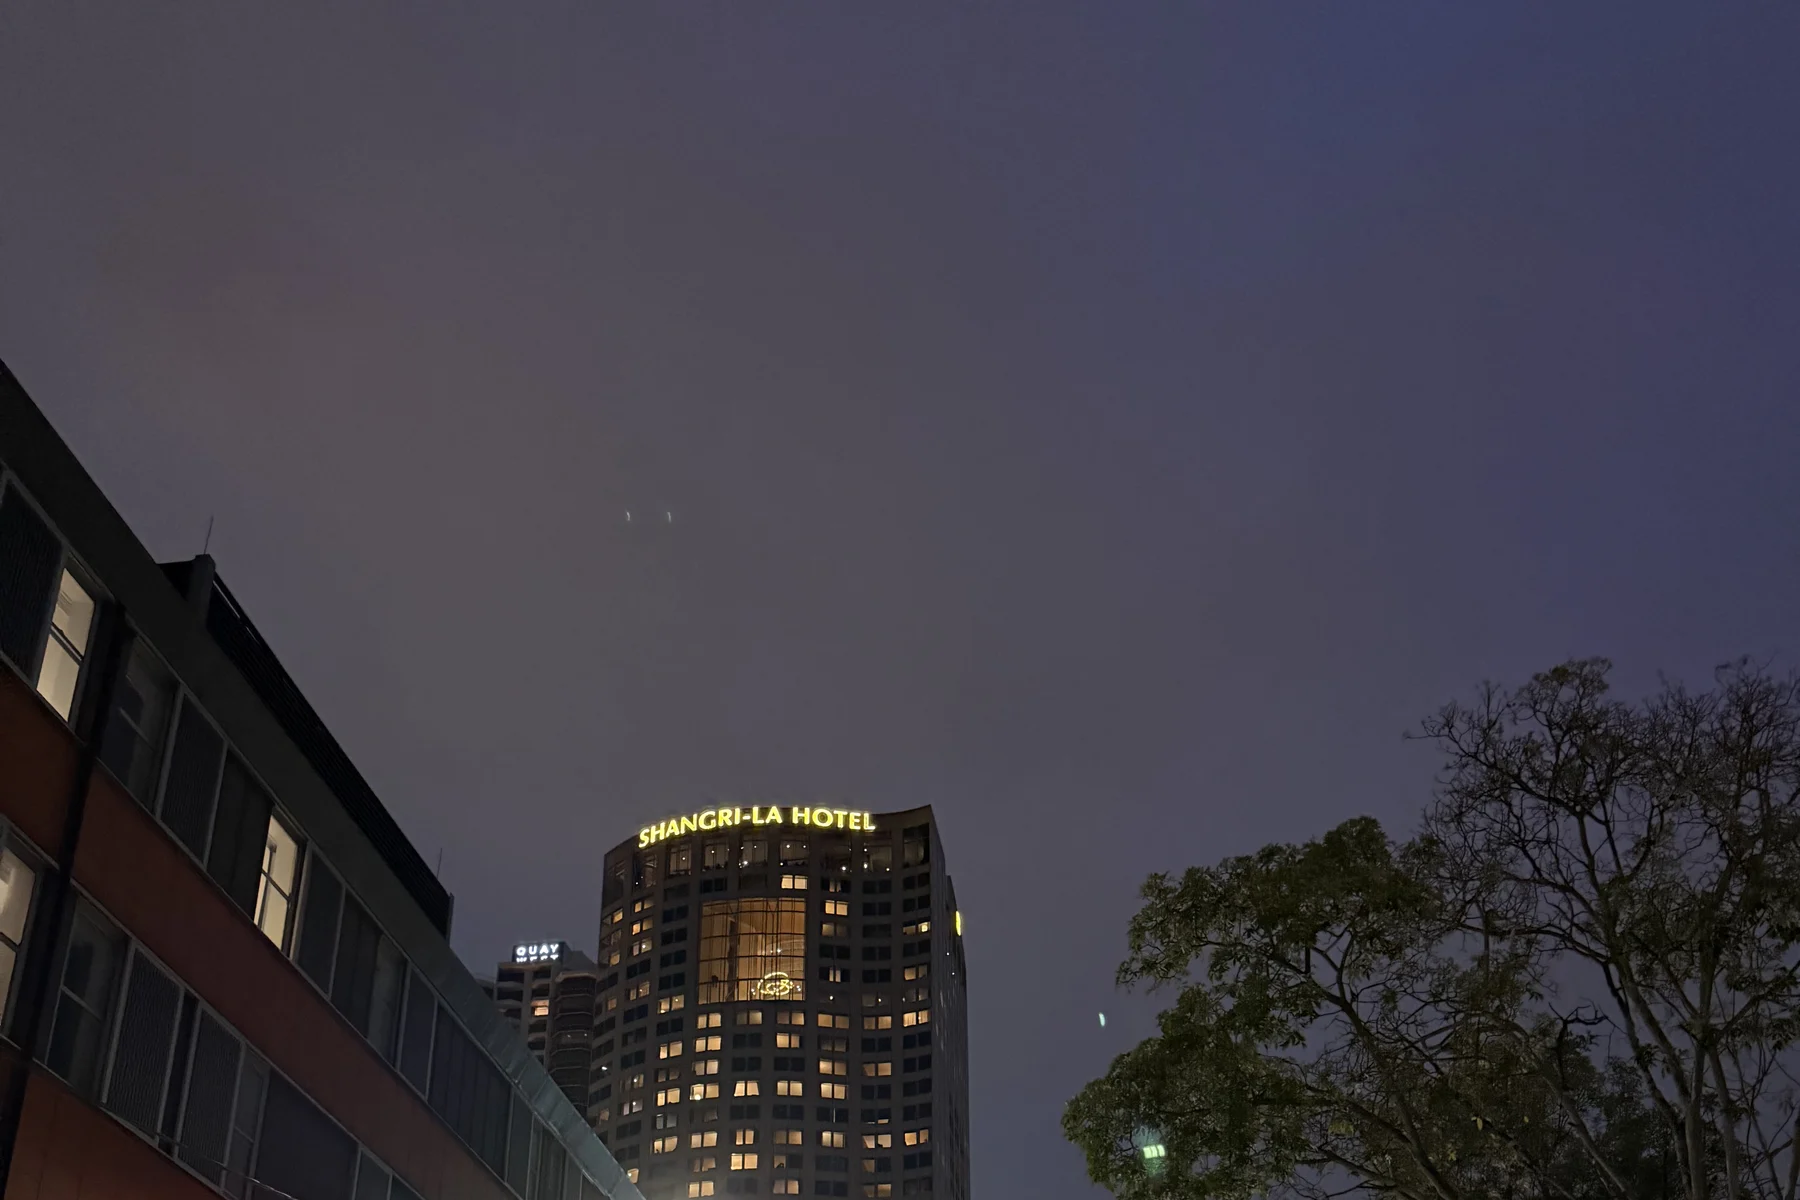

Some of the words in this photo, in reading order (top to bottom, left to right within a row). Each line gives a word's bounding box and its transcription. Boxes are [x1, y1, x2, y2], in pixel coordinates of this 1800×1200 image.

[637, 805, 783, 849] SHANGRI-LA
[791, 806, 876, 831] HOTEL
[516, 943, 560, 956] QUAY
